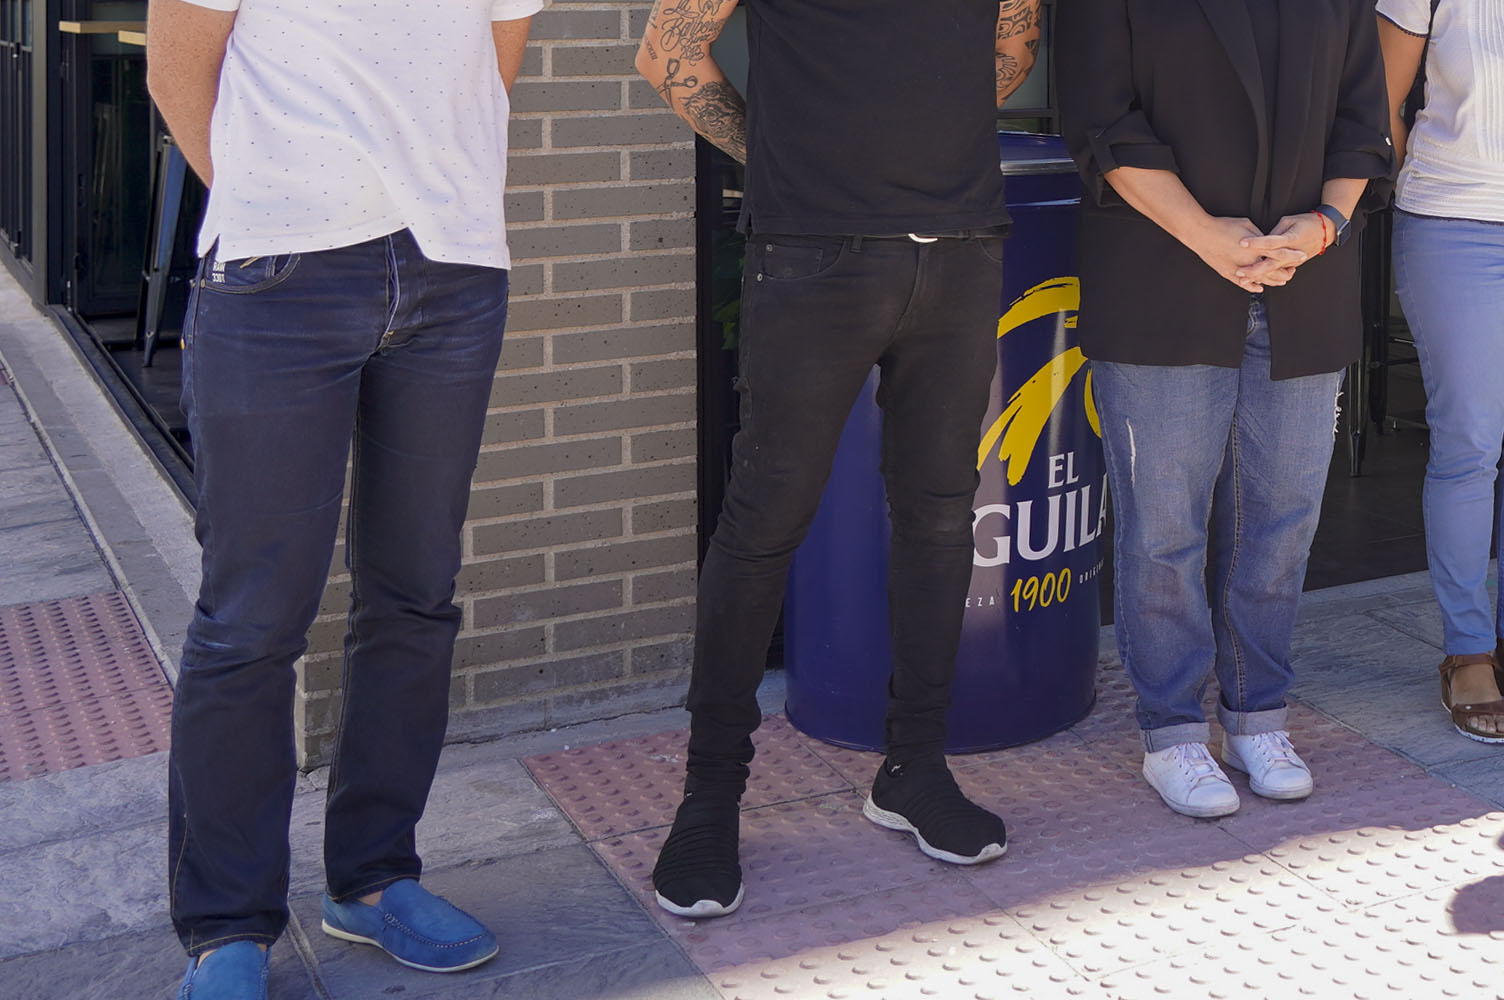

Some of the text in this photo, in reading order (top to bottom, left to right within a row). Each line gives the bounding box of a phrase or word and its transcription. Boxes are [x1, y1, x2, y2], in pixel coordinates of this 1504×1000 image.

[1048, 451, 1079, 489] EL
[972, 472, 1107, 567] GUILA
[965, 595, 996, 608] EZA
[1010, 567, 1072, 613] 1900
